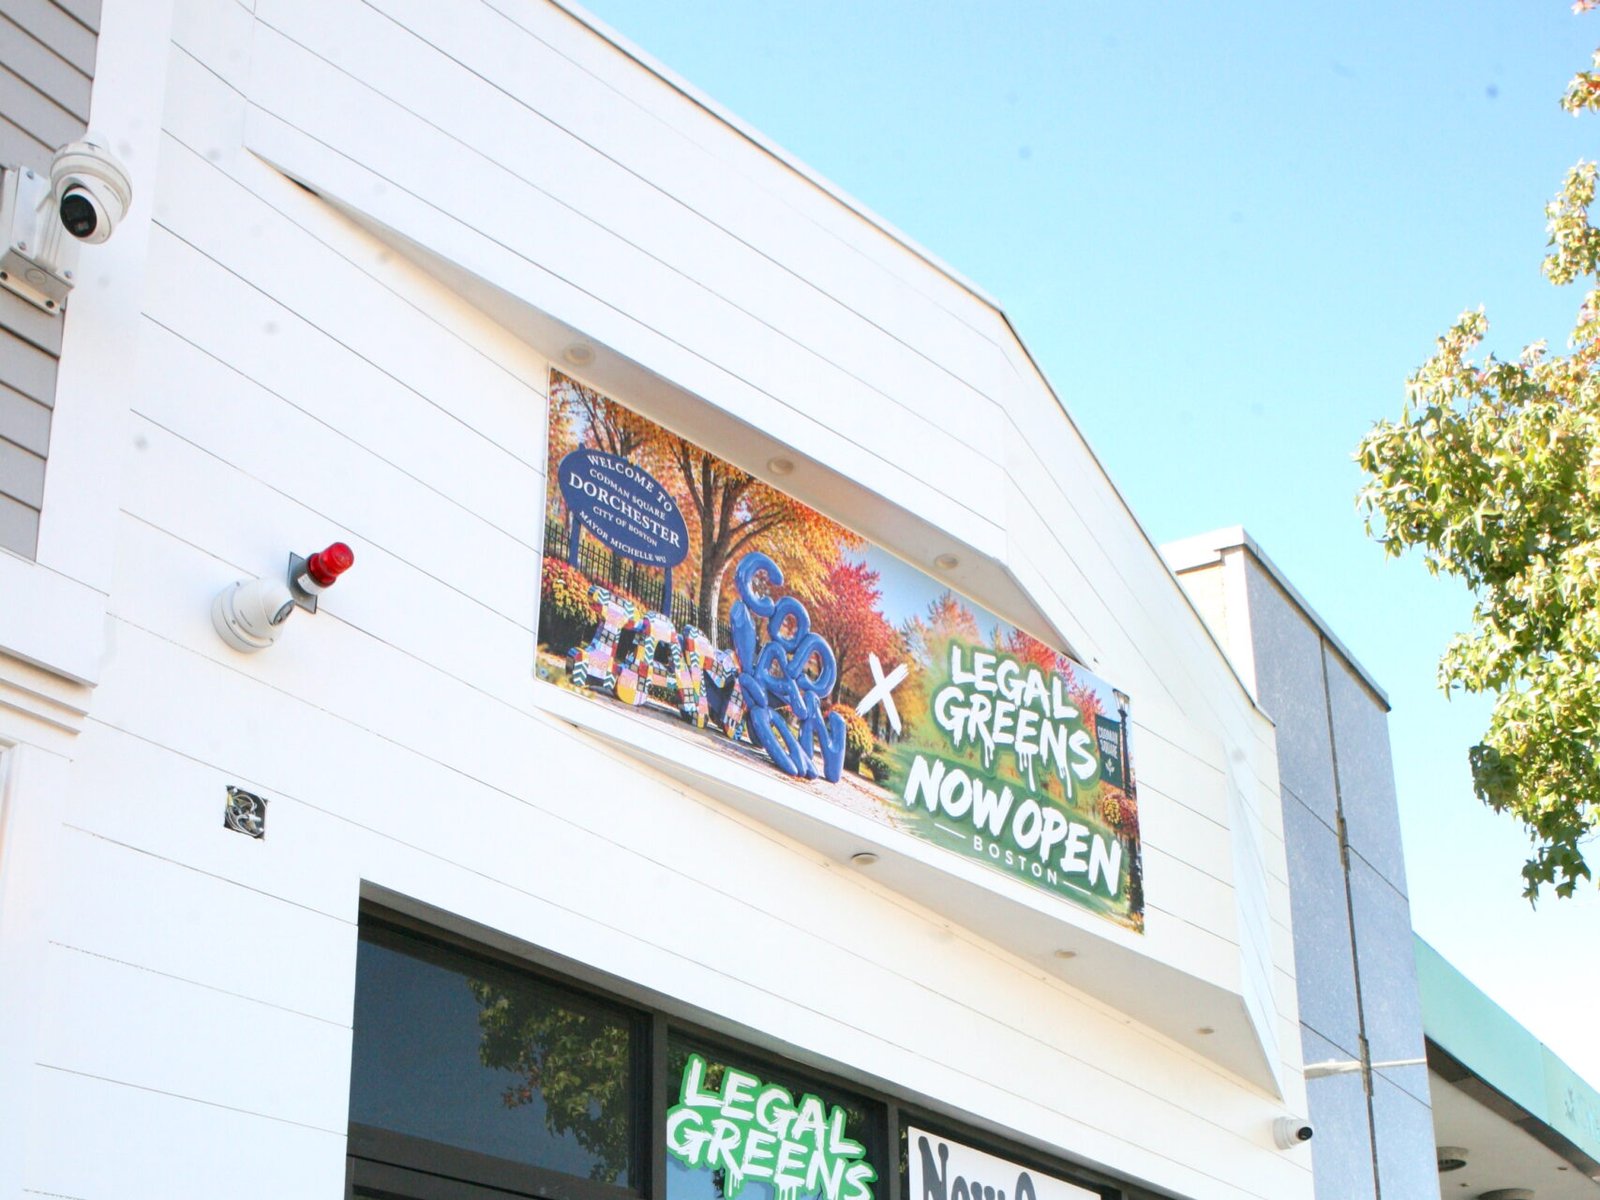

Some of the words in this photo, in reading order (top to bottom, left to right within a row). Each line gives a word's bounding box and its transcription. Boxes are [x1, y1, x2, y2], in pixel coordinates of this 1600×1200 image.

[568, 471, 681, 548] DORCHESTER
[586, 455, 655, 493] WELCOME
[656, 491, 673, 512] TO
[589, 468, 630, 499] CODMAN
[631, 495, 667, 520] SQUARE
[580, 510, 608, 541] MAYOR
[610, 537, 655, 561] MICHELLE
[592, 505, 614, 522] CITY
[615, 517, 626, 528] OF
[628, 523, 658, 548] BOSTON
[854, 652, 909, 736] X
[951, 645, 1079, 720] LEGAL
[934, 686, 1098, 799] GREENS
[904, 754, 1015, 837] NOW
[1012, 799, 1123, 897] OPEN
[973, 834, 1059, 886] BOSTON
[684, 1058, 863, 1155] LEGAL
